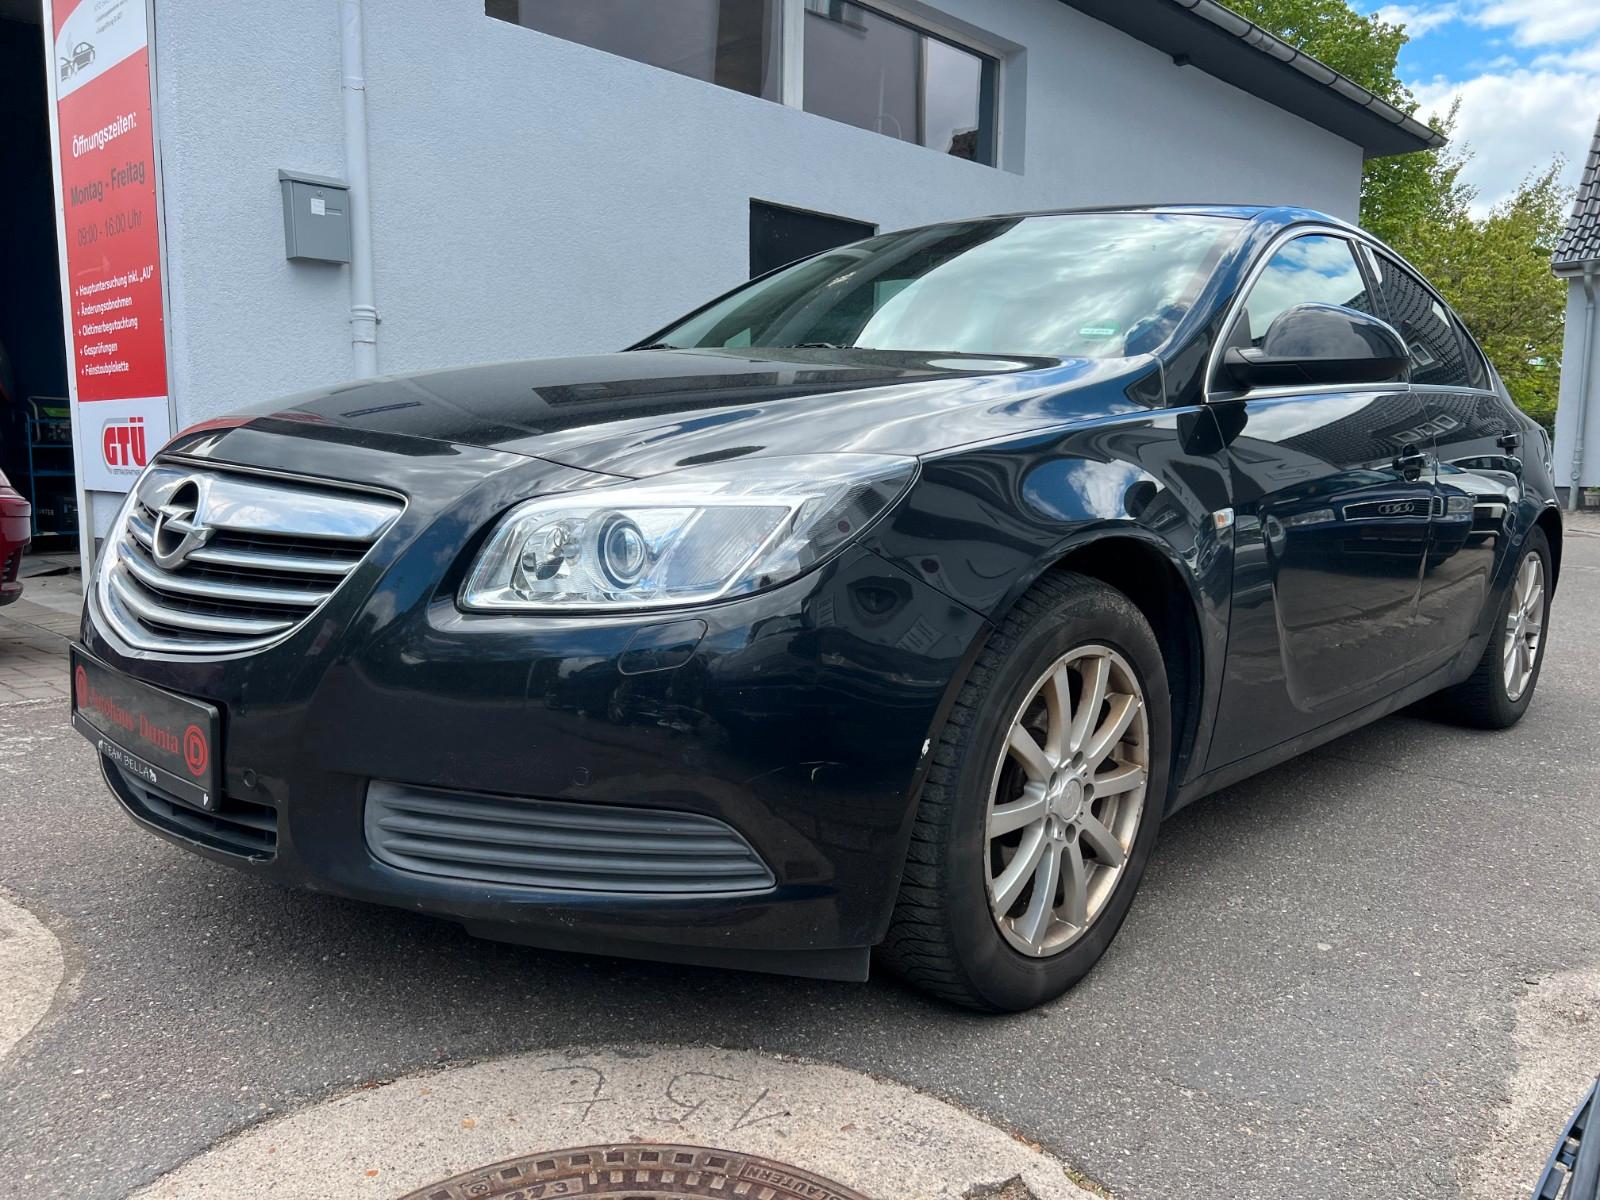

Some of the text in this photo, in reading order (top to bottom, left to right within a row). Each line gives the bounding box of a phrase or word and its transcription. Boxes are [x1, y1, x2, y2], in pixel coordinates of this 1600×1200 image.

[72, 111, 137, 158] Öffnungszeiten:
[70, 180, 104, 208] Montag
[110, 160, 145, 190] Freitag
[79, 275, 128, 297] Hauptuntersuchung
[103, 416, 147, 468] GTÜ
[123, 755, 150, 780] BELLA
